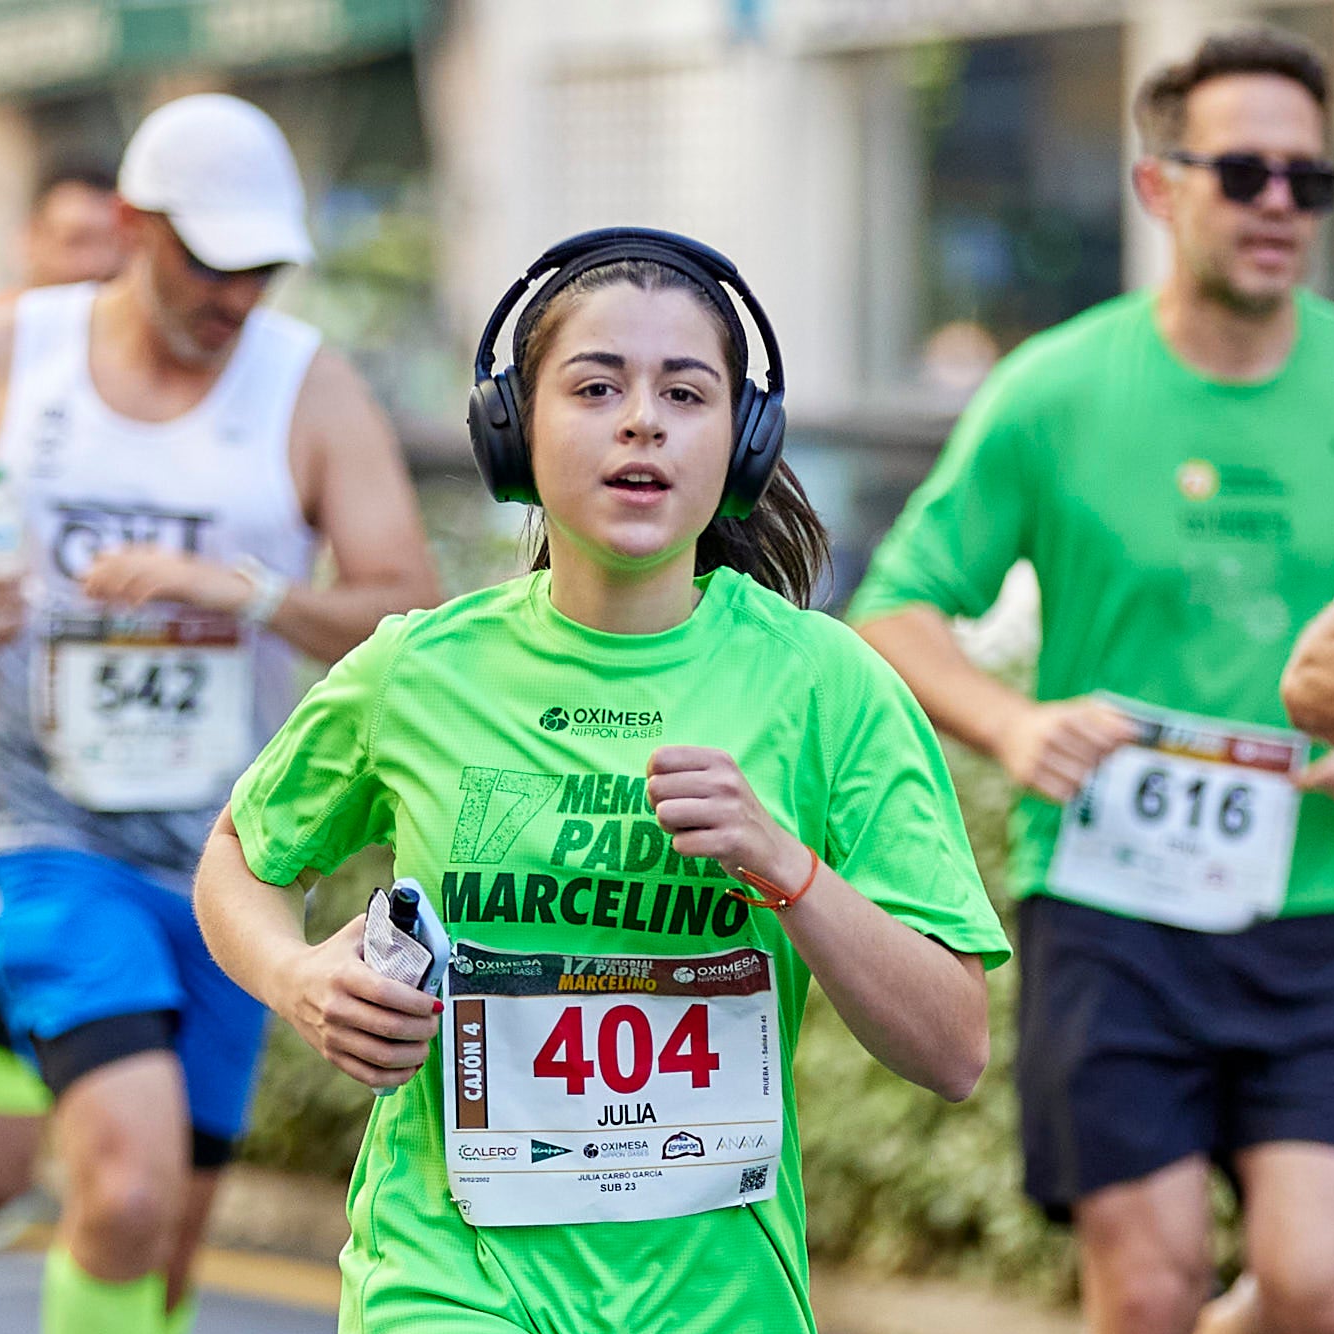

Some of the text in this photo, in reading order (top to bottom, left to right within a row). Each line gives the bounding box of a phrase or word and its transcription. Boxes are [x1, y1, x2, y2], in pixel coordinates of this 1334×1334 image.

[94, 661, 207, 715] 542
[573, 708, 663, 726] OXIMESA
[570, 726, 663, 739] NIPPON GASES
[1133, 767, 1254, 837] 616
[450, 766, 563, 864] 17
[441, 871, 750, 938] MARCELINO
[562, 956, 594, 975] 17
[594, 958, 654, 969] MEMORIAL
[595, 964, 651, 979] PADRE
[697, 954, 760, 976] OXIMESA
[558, 974, 657, 992] MARCELINO
[533, 1003, 719, 1095] 404
[459, 1022, 483, 1101] CAJÓN 4
[597, 1102, 657, 1127] JULIA
[463, 1147, 517, 1157] CALERO
[600, 1140, 649, 1151] OXIMESA
[578, 1173, 601, 1182] JULIA
[600, 1182, 637, 1193] SUB 23
